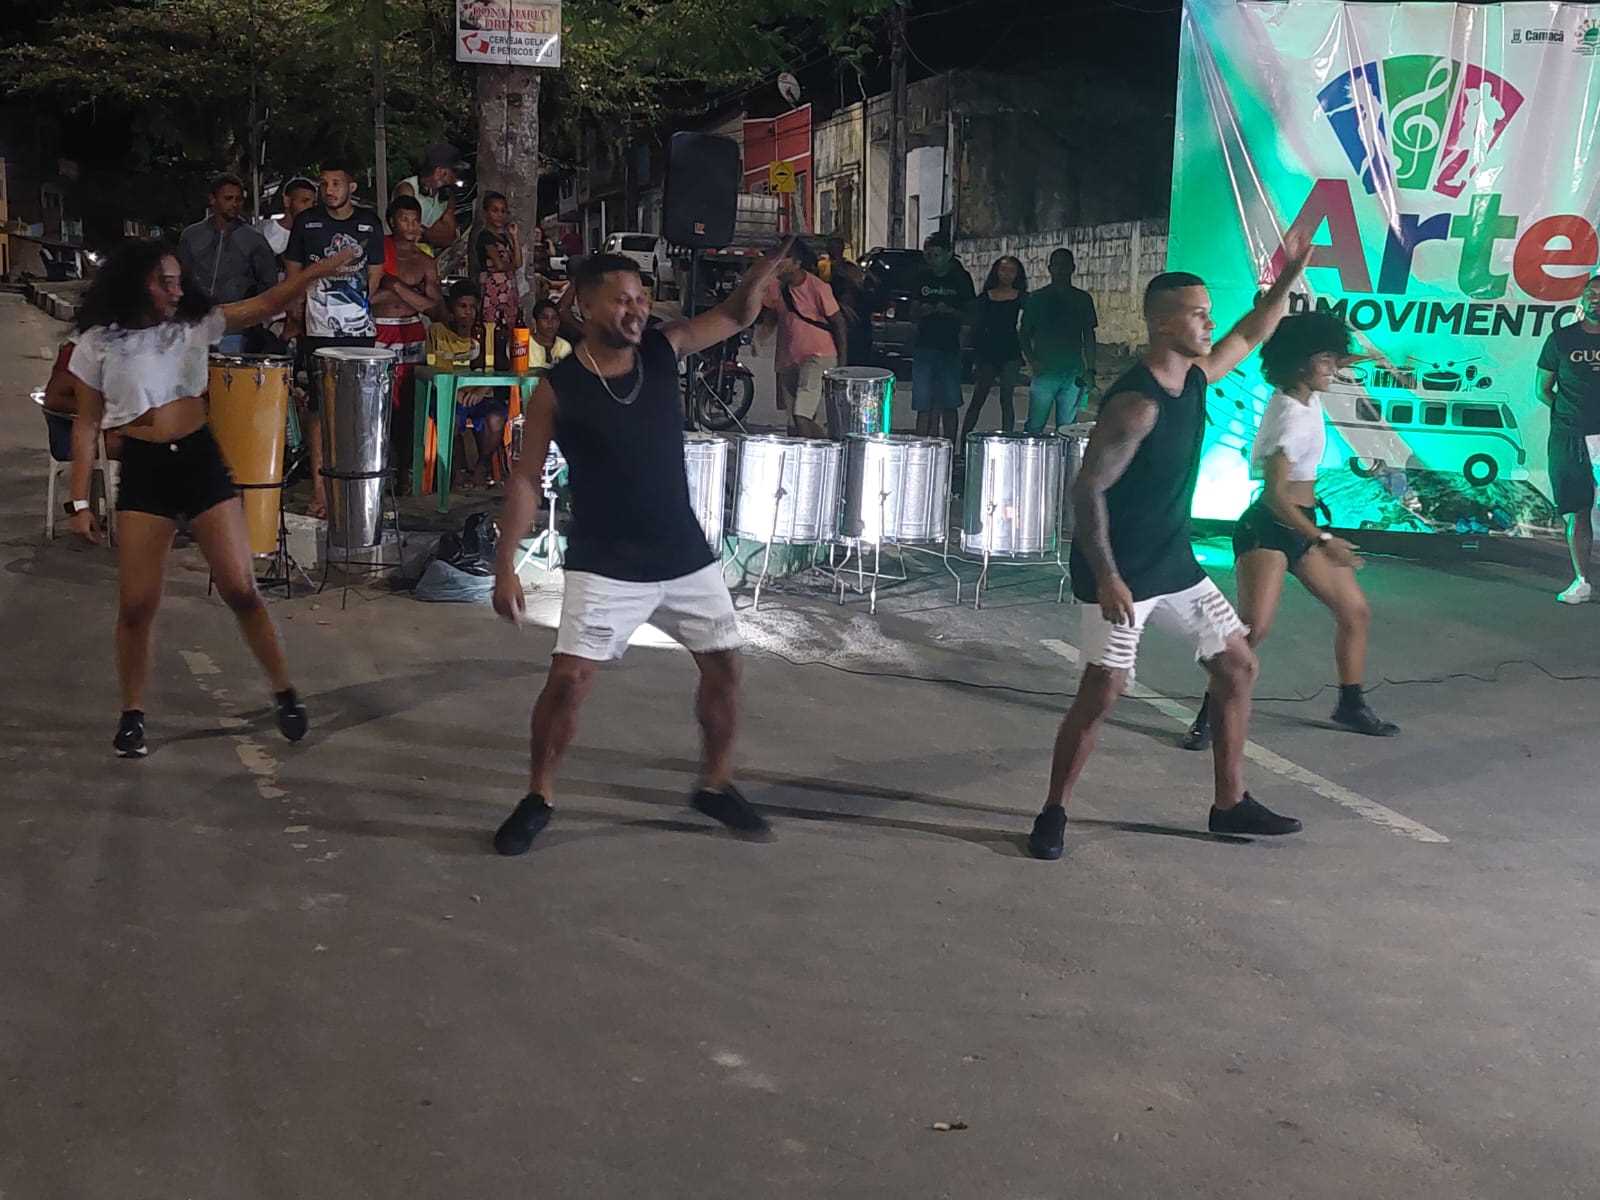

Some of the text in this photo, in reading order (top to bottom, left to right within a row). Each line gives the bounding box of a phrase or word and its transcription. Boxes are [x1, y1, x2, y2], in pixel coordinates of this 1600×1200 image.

[488, 35, 523, 46] CERVEJA
[1257, 178, 1598, 301] Arte
[1316, 296, 1578, 338] MOVIMENTO
